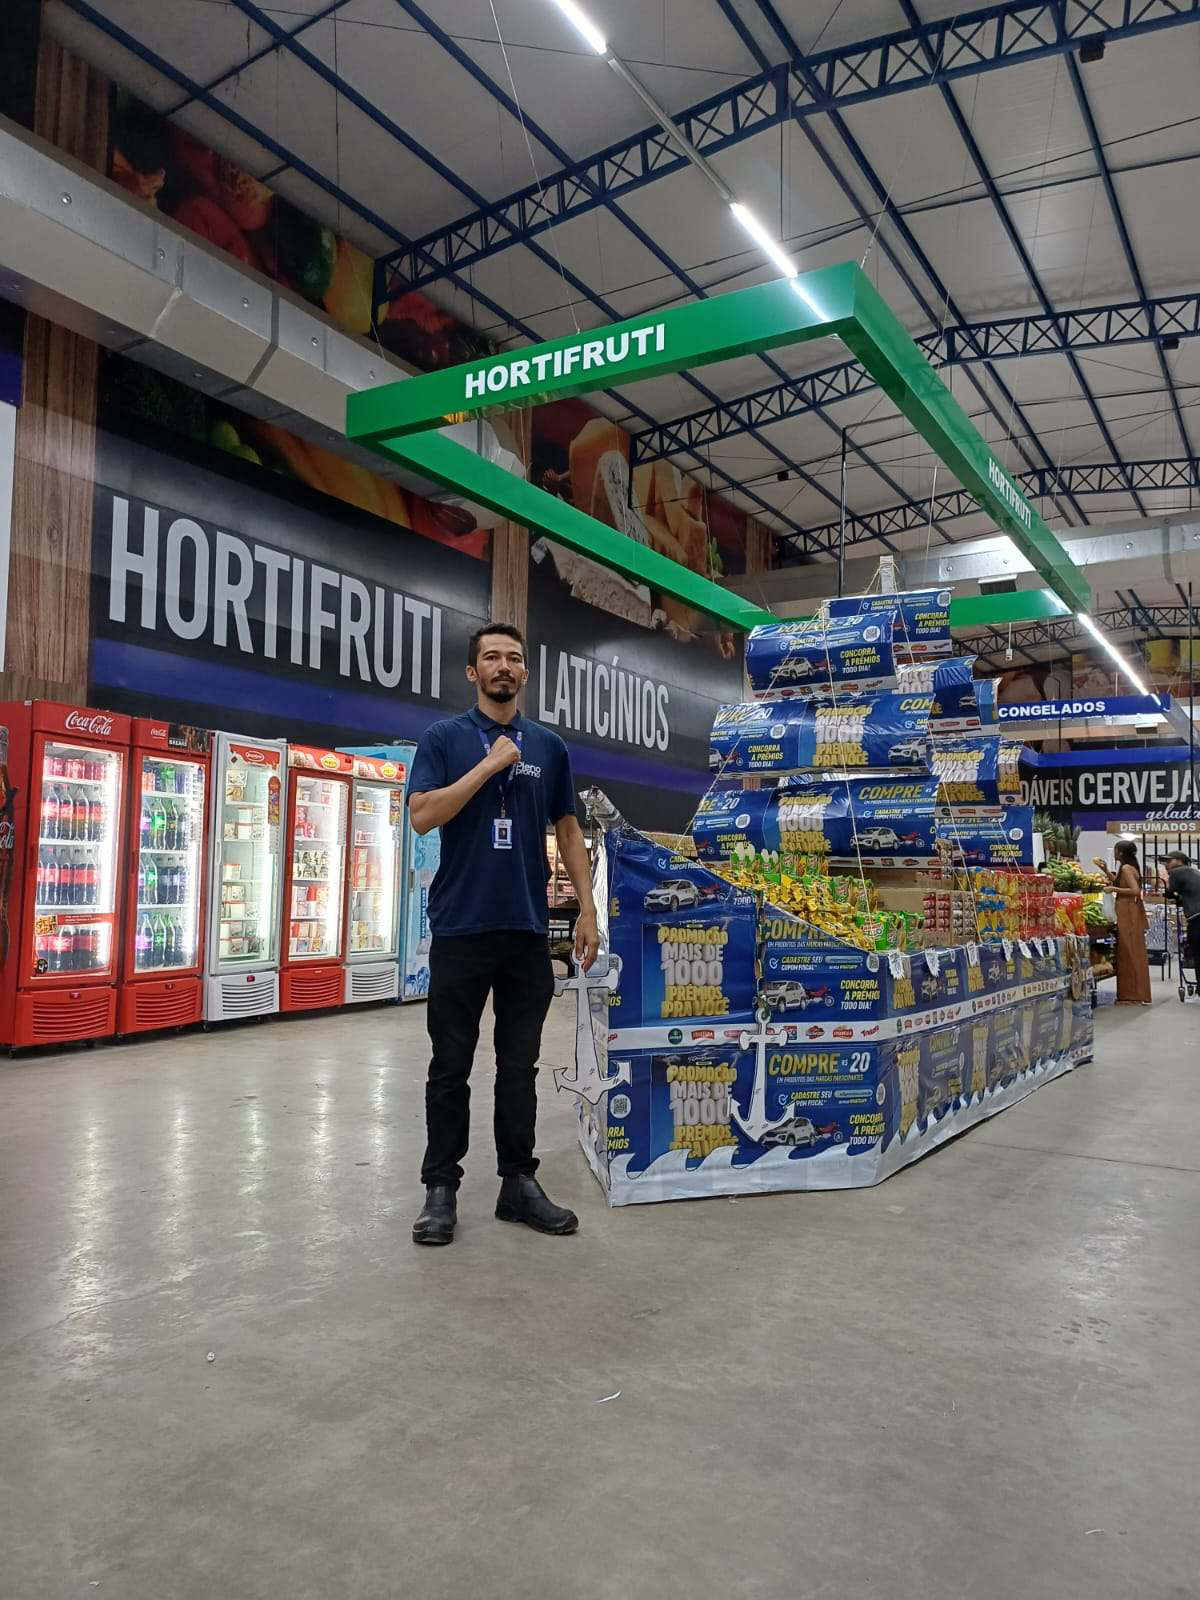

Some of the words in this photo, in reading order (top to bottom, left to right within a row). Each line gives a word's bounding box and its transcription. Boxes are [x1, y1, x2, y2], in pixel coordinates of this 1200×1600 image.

[465, 323, 665, 398] HORTIFRUTI
[988, 457, 1031, 529] HORTIFRUTI
[109, 496, 442, 699] HORTIFRUTI
[914, 611, 948, 621] CONCORRA
[840, 647, 876, 658] CONCORRA
[845, 659, 851, 667] A
[859, 664, 871, 672] DIA!
[538, 644, 669, 751] LATICÍNIOS
[998, 701, 1106, 717] CONGELADOS
[65, 710, 114, 736] Coca-Cola
[747, 744, 781, 753] CONCORRA
[859, 784, 925, 800] COMPRE
[1078, 770, 1200, 805] CERVEJA
[1119, 822, 1197, 833] DEFUMADOS
[661, 942, 703, 961] MAIS
[703, 943, 724, 961] DE
[781, 956, 811, 964] CADASTRE
[811, 955, 823, 963] SEU
[660, 959, 723, 986] 1000
[845, 991, 850, 1000] A
[841, 1001, 857, 1010] TODO
[858, 1000, 872, 1009] DIA!
[768, 1053, 840, 1076] COMPRE
[849, 1051, 871, 1073] 20
[669, 1080, 711, 1101] MAIS
[790, 1091, 820, 1100] CADASTRE
[821, 1090, 832, 1098] SEU
[849, 1136, 866, 1146] TODO
